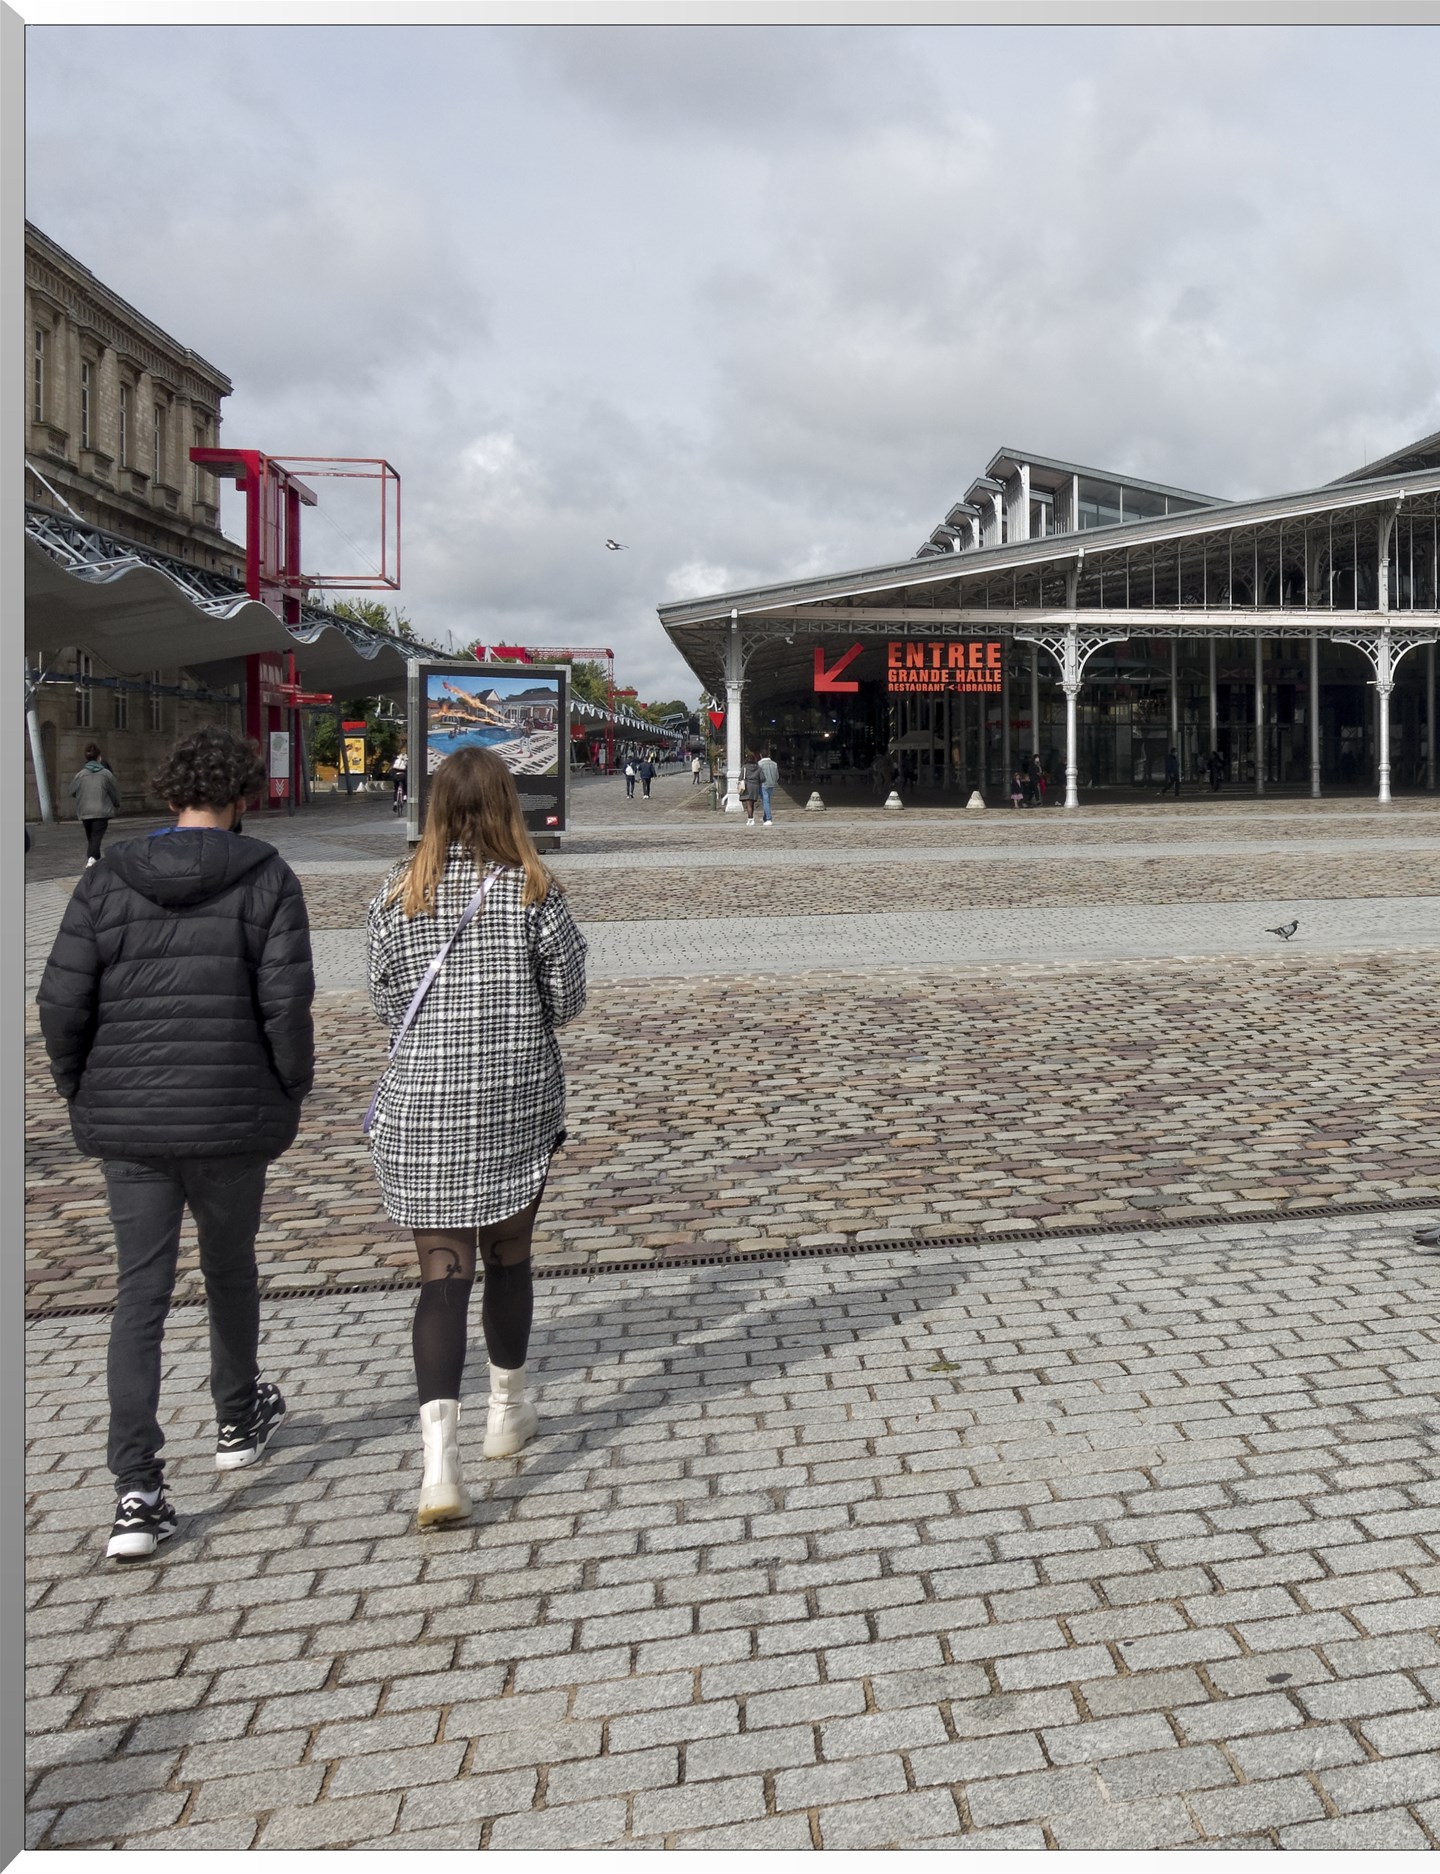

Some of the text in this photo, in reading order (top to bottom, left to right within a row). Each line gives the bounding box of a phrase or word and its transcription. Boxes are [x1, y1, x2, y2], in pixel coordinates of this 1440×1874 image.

[888, 642, 1002, 668] ENTREE
[888, 669, 1002, 682] GRANDE HALLE
[888, 683, 1002, 692] RESTAURANT LIBRAIRIE
